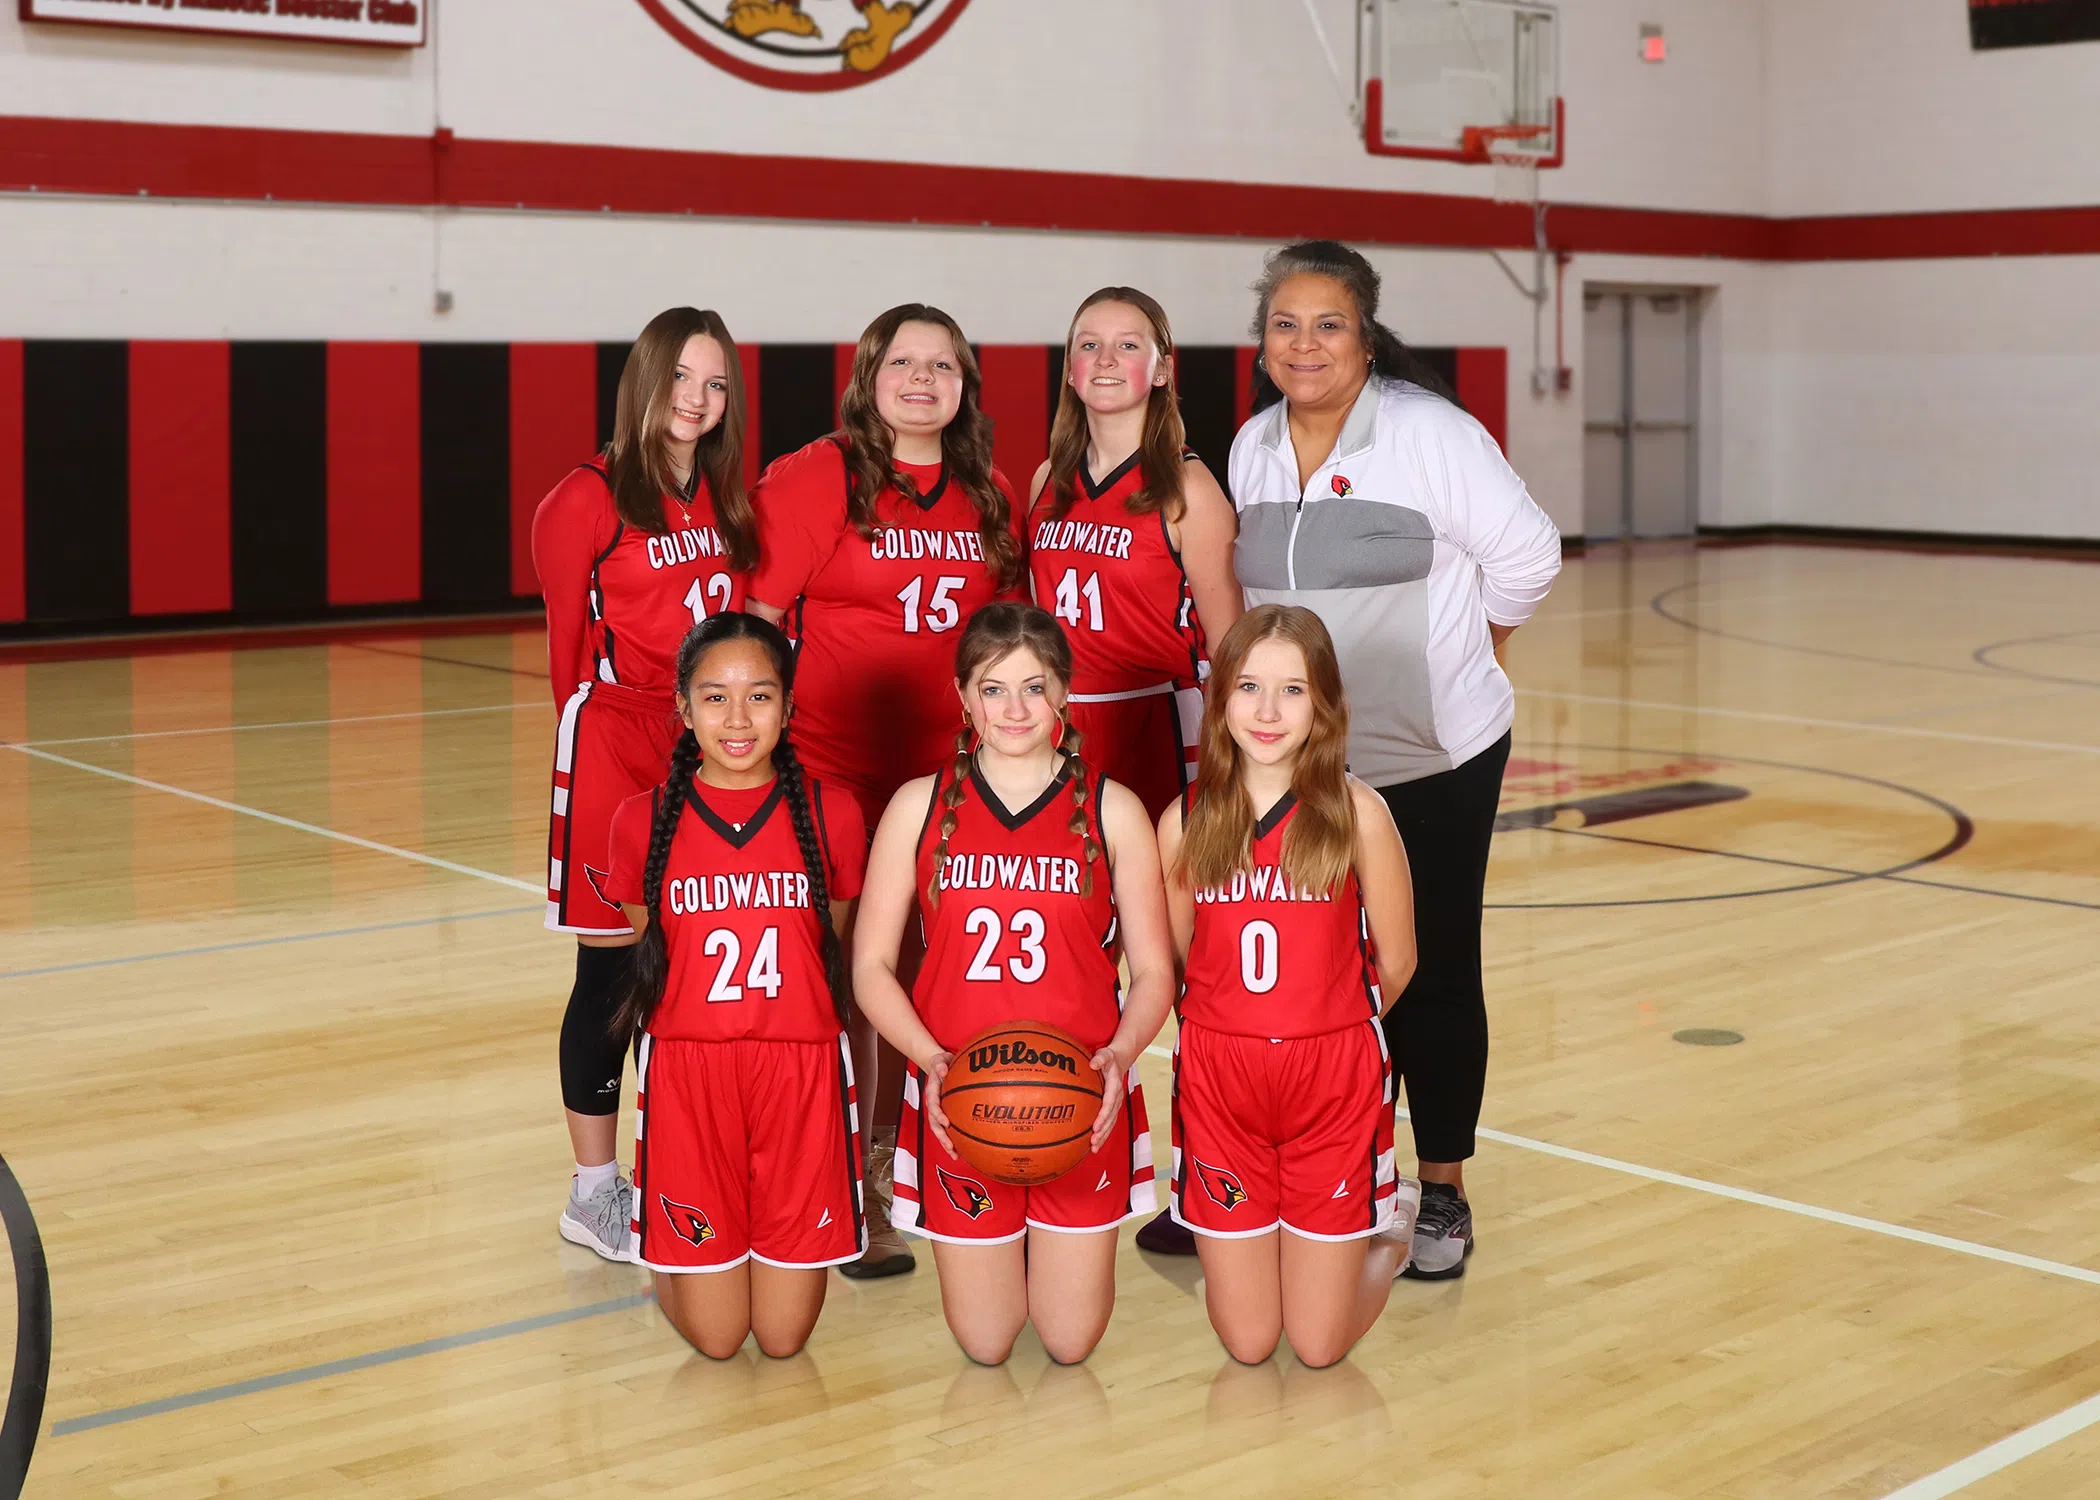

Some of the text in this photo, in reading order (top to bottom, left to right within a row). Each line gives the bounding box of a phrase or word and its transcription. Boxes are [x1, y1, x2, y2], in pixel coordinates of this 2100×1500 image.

[647, 526, 725, 570] COLDWA
[1033, 520, 1133, 560] COLDWATER
[683, 572, 733, 625] 12
[897, 575, 966, 633] 15
[1055, 567, 1105, 632] 41
[669, 872, 810, 915] COLDWATER
[939, 853, 1080, 894] COLDWATER
[703, 926, 783, 1003] 24
[964, 906, 1047, 984] 23
[1240, 919, 1280, 994] 0
[967, 1040, 1077, 1076] Wilson
[971, 1103, 1076, 1120] EVOLUTION
